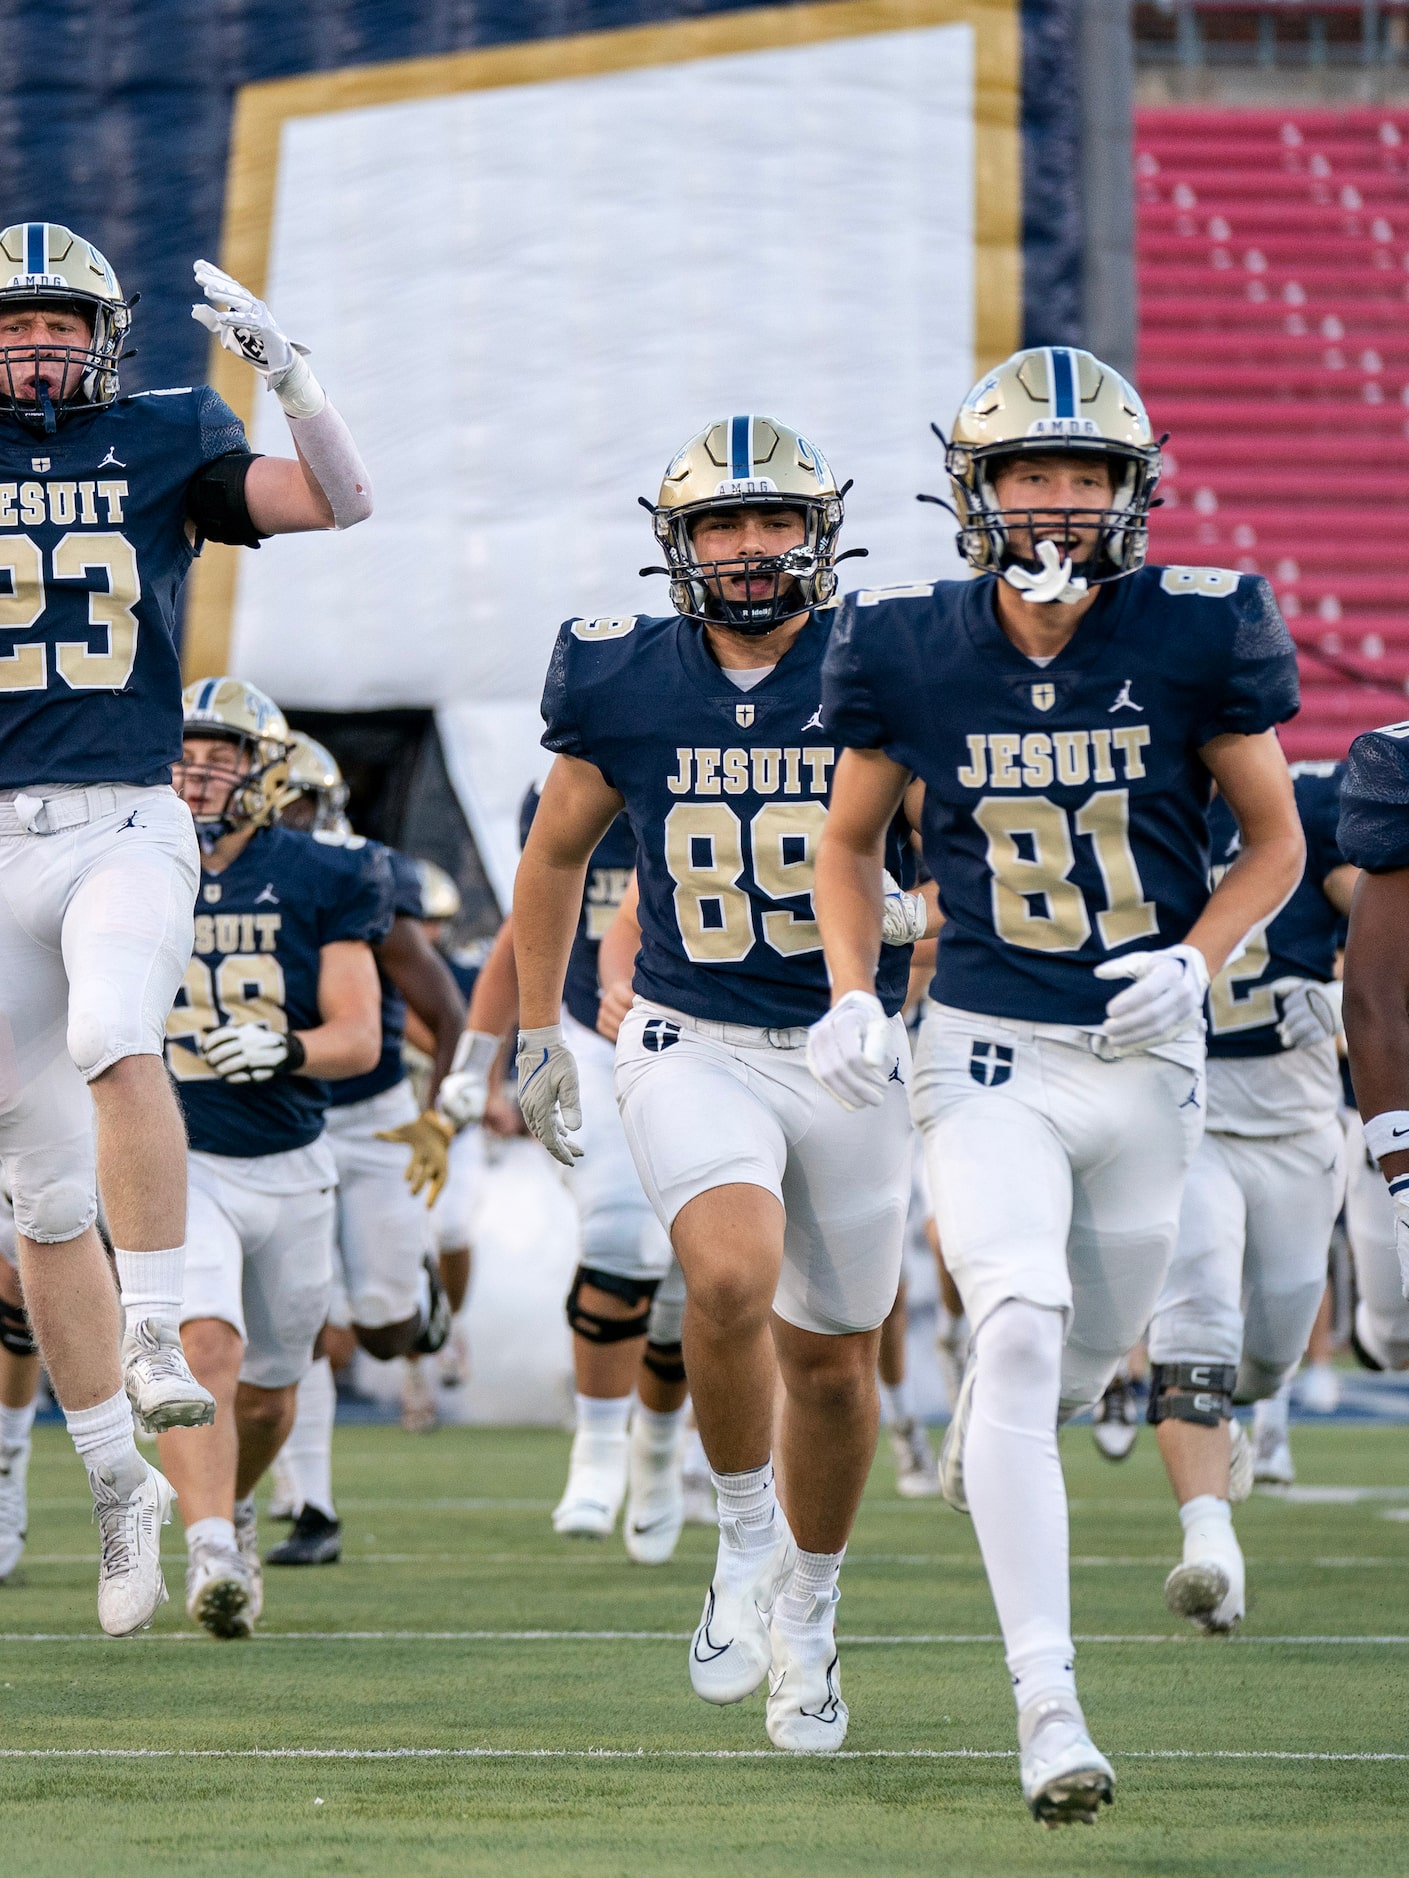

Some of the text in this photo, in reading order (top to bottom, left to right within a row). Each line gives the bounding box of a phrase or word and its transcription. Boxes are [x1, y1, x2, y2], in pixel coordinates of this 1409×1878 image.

[666, 747, 835, 795] JESUIT
[958, 725, 1152, 790] JESUIT
[664, 801, 830, 963] 89
[973, 789, 1160, 953] 81
[194, 912, 282, 954] SUIT
